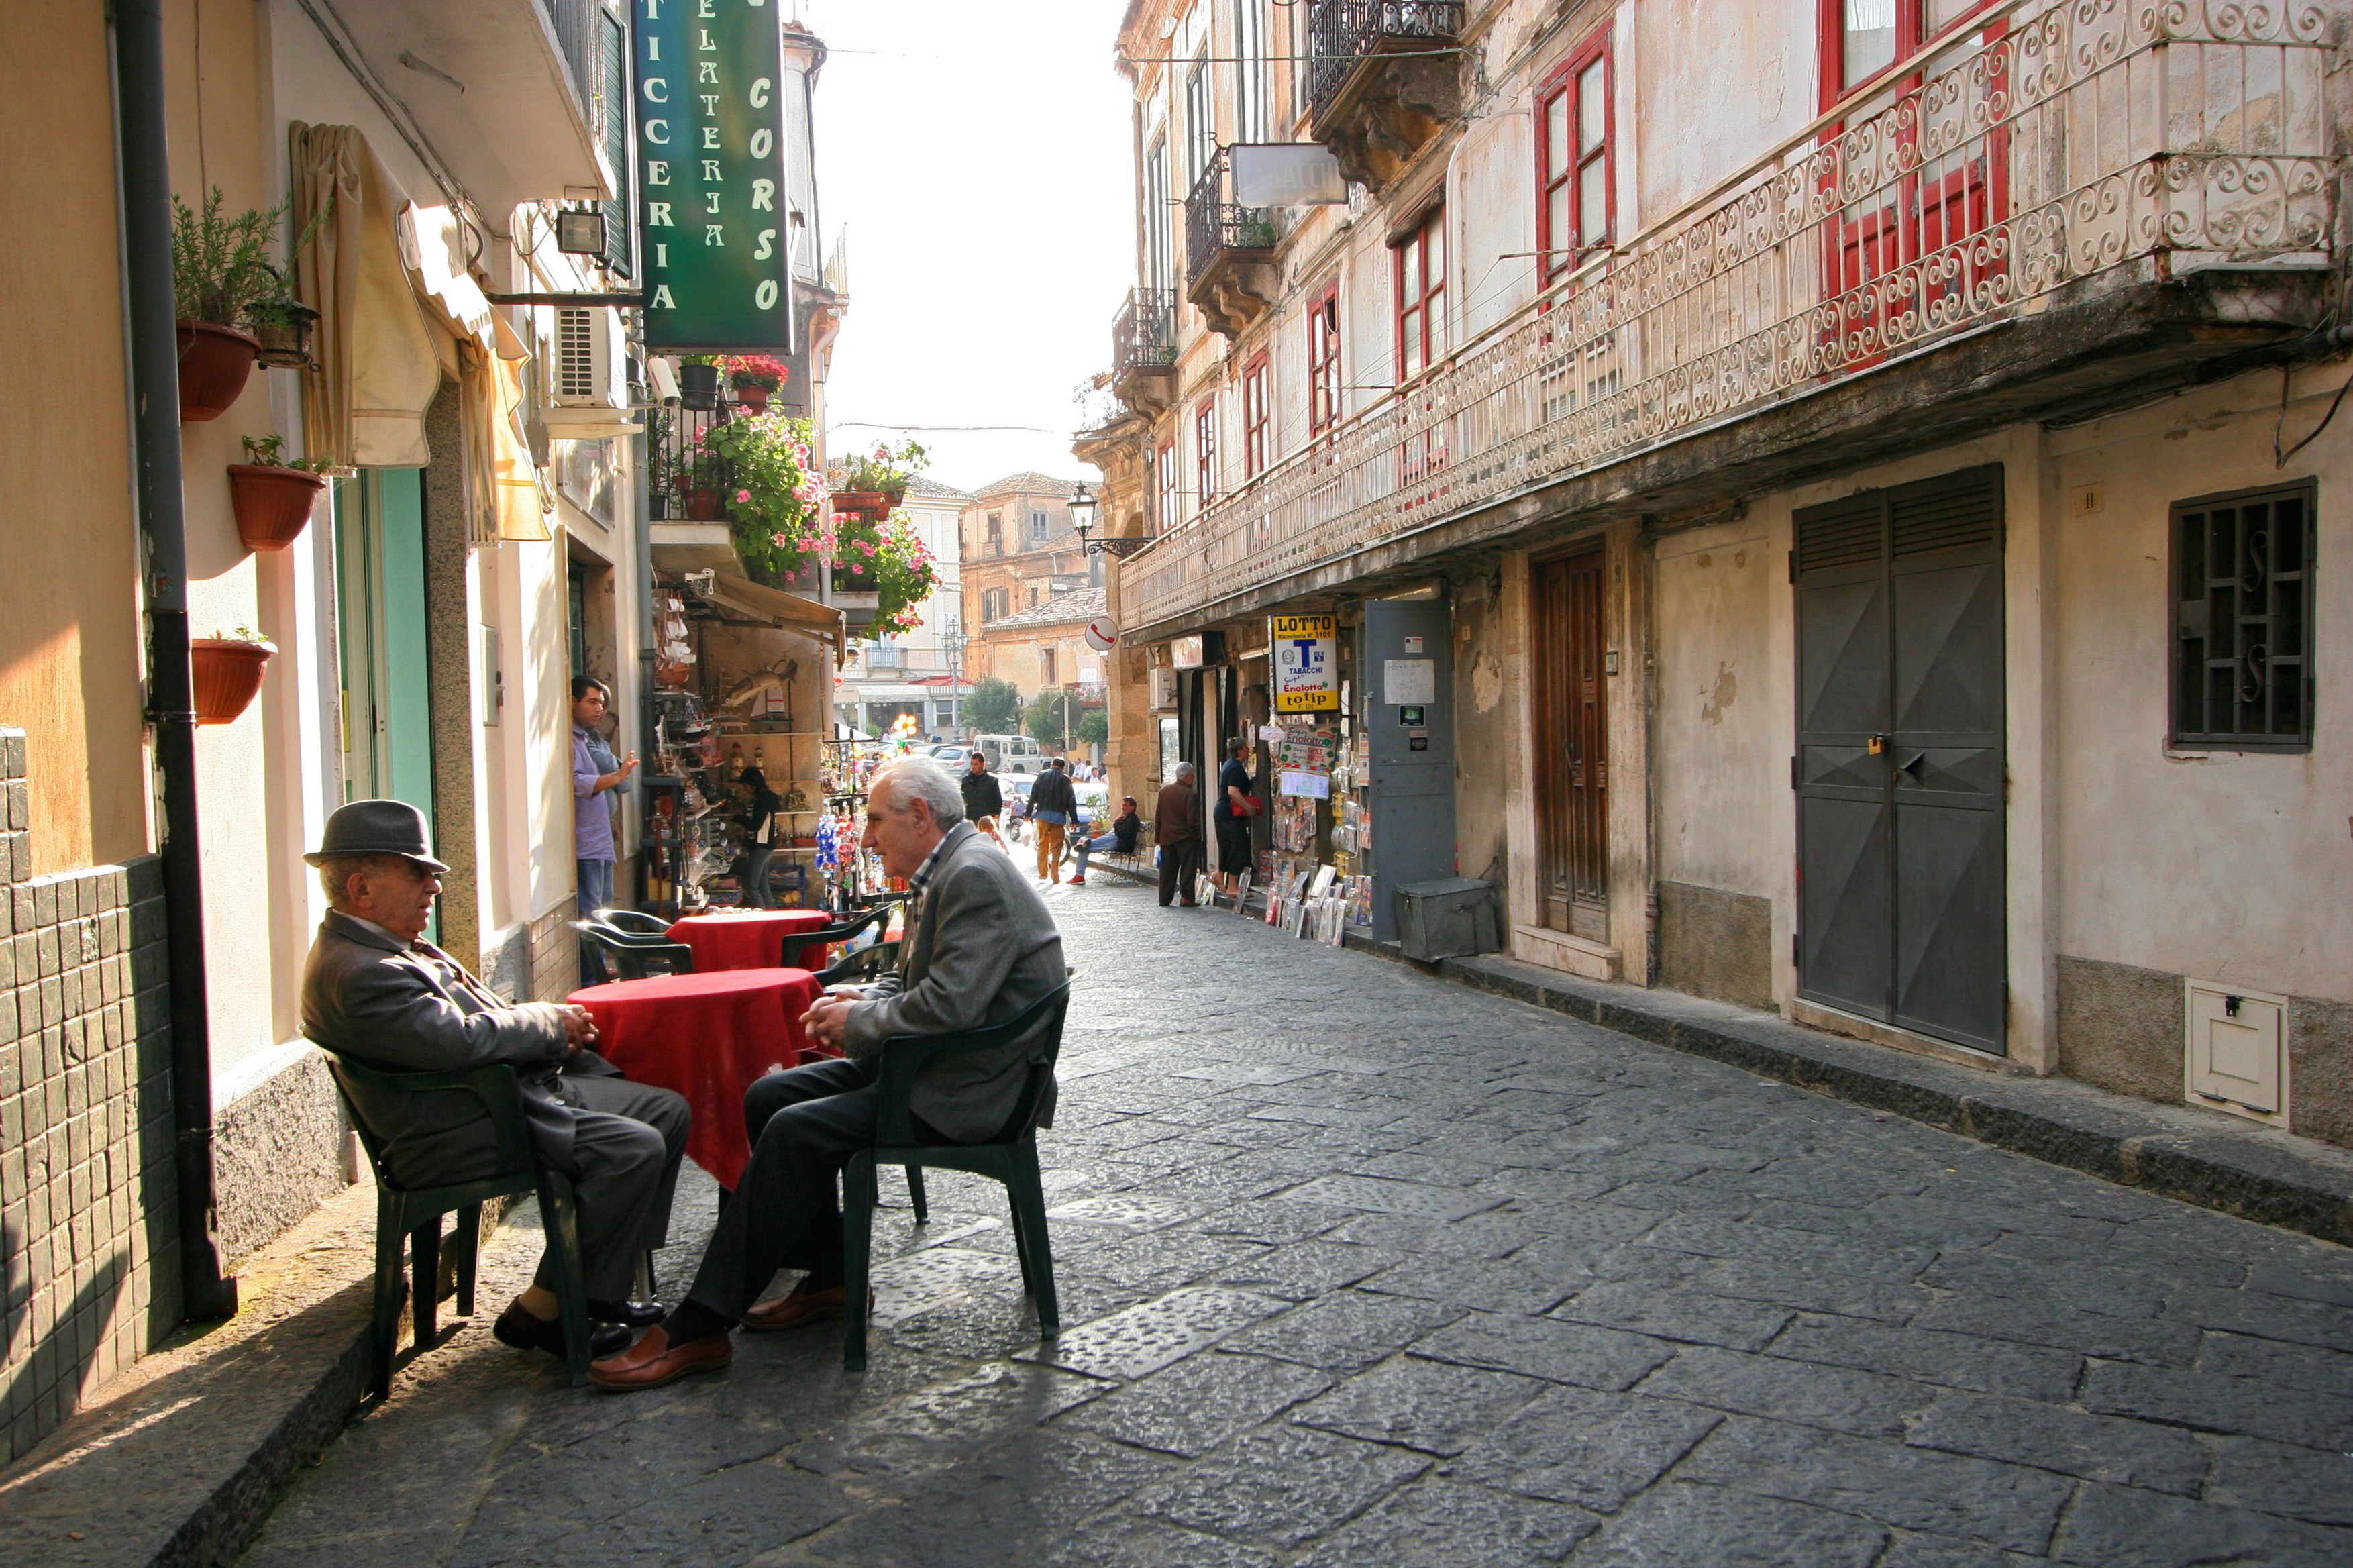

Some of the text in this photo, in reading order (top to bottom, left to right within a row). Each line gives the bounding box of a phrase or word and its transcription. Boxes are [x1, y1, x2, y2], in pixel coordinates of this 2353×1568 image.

[749, 77, 778, 311] CORSO
[1278, 617, 1330, 631] LOTTO
[1293, 639, 1316, 667] T
[1284, 674, 1305, 684] Super
[1287, 692, 1326, 705] totip
[1287, 734, 1324, 745] Enalotto
